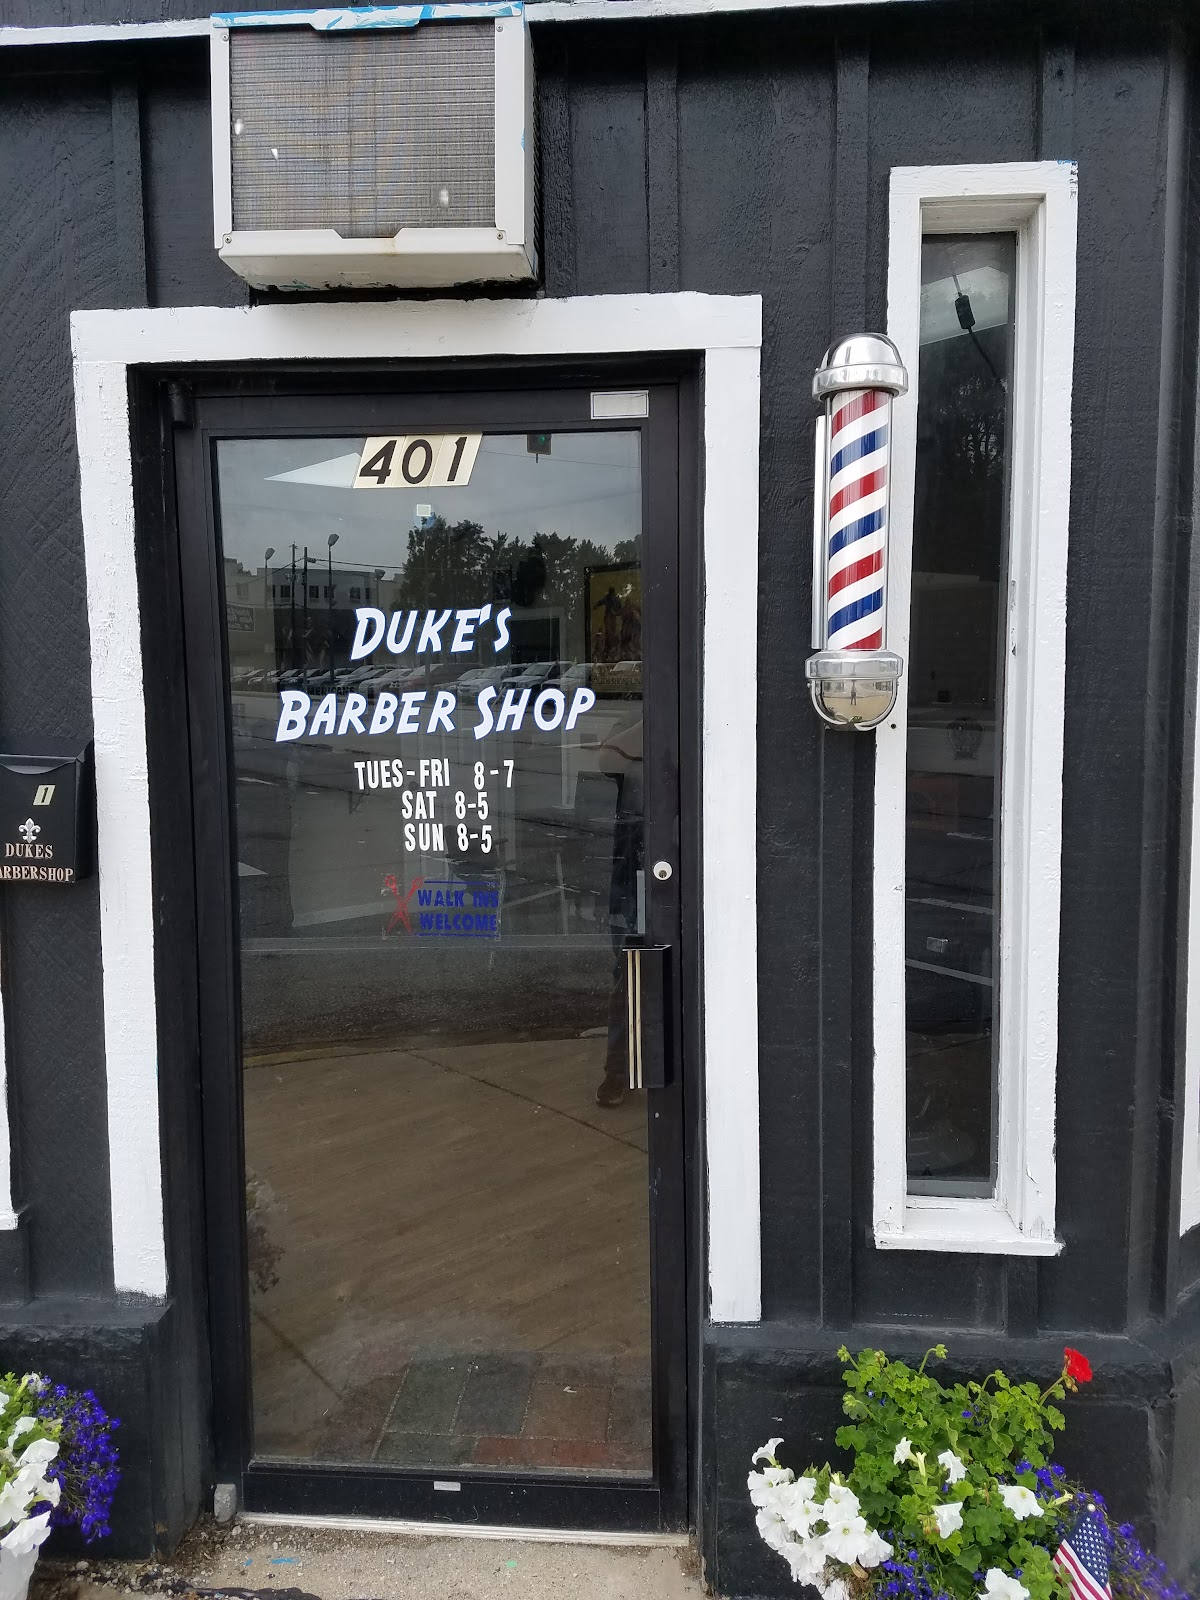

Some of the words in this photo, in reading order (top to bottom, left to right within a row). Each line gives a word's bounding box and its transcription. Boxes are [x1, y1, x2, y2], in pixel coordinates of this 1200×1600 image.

[359, 437, 468, 485] 401
[350, 603, 512, 661] DUKE'S
[303, 686, 355, 696] MERICANS
[275, 690, 457, 743] BARBER
[473, 685, 596, 740] SHOP
[41, 786, 49, 803] 1
[401, 790, 437, 820] SAT
[454, 791, 489, 821] 8-5
[5, 842, 54, 859] DUKES
[403, 822, 445, 852] SUN
[456, 824, 492, 854] 8-5
[417, 889, 466, 908] WALK
[472, 890, 500, 909] INS
[419, 912, 497, 932] WELCOME
